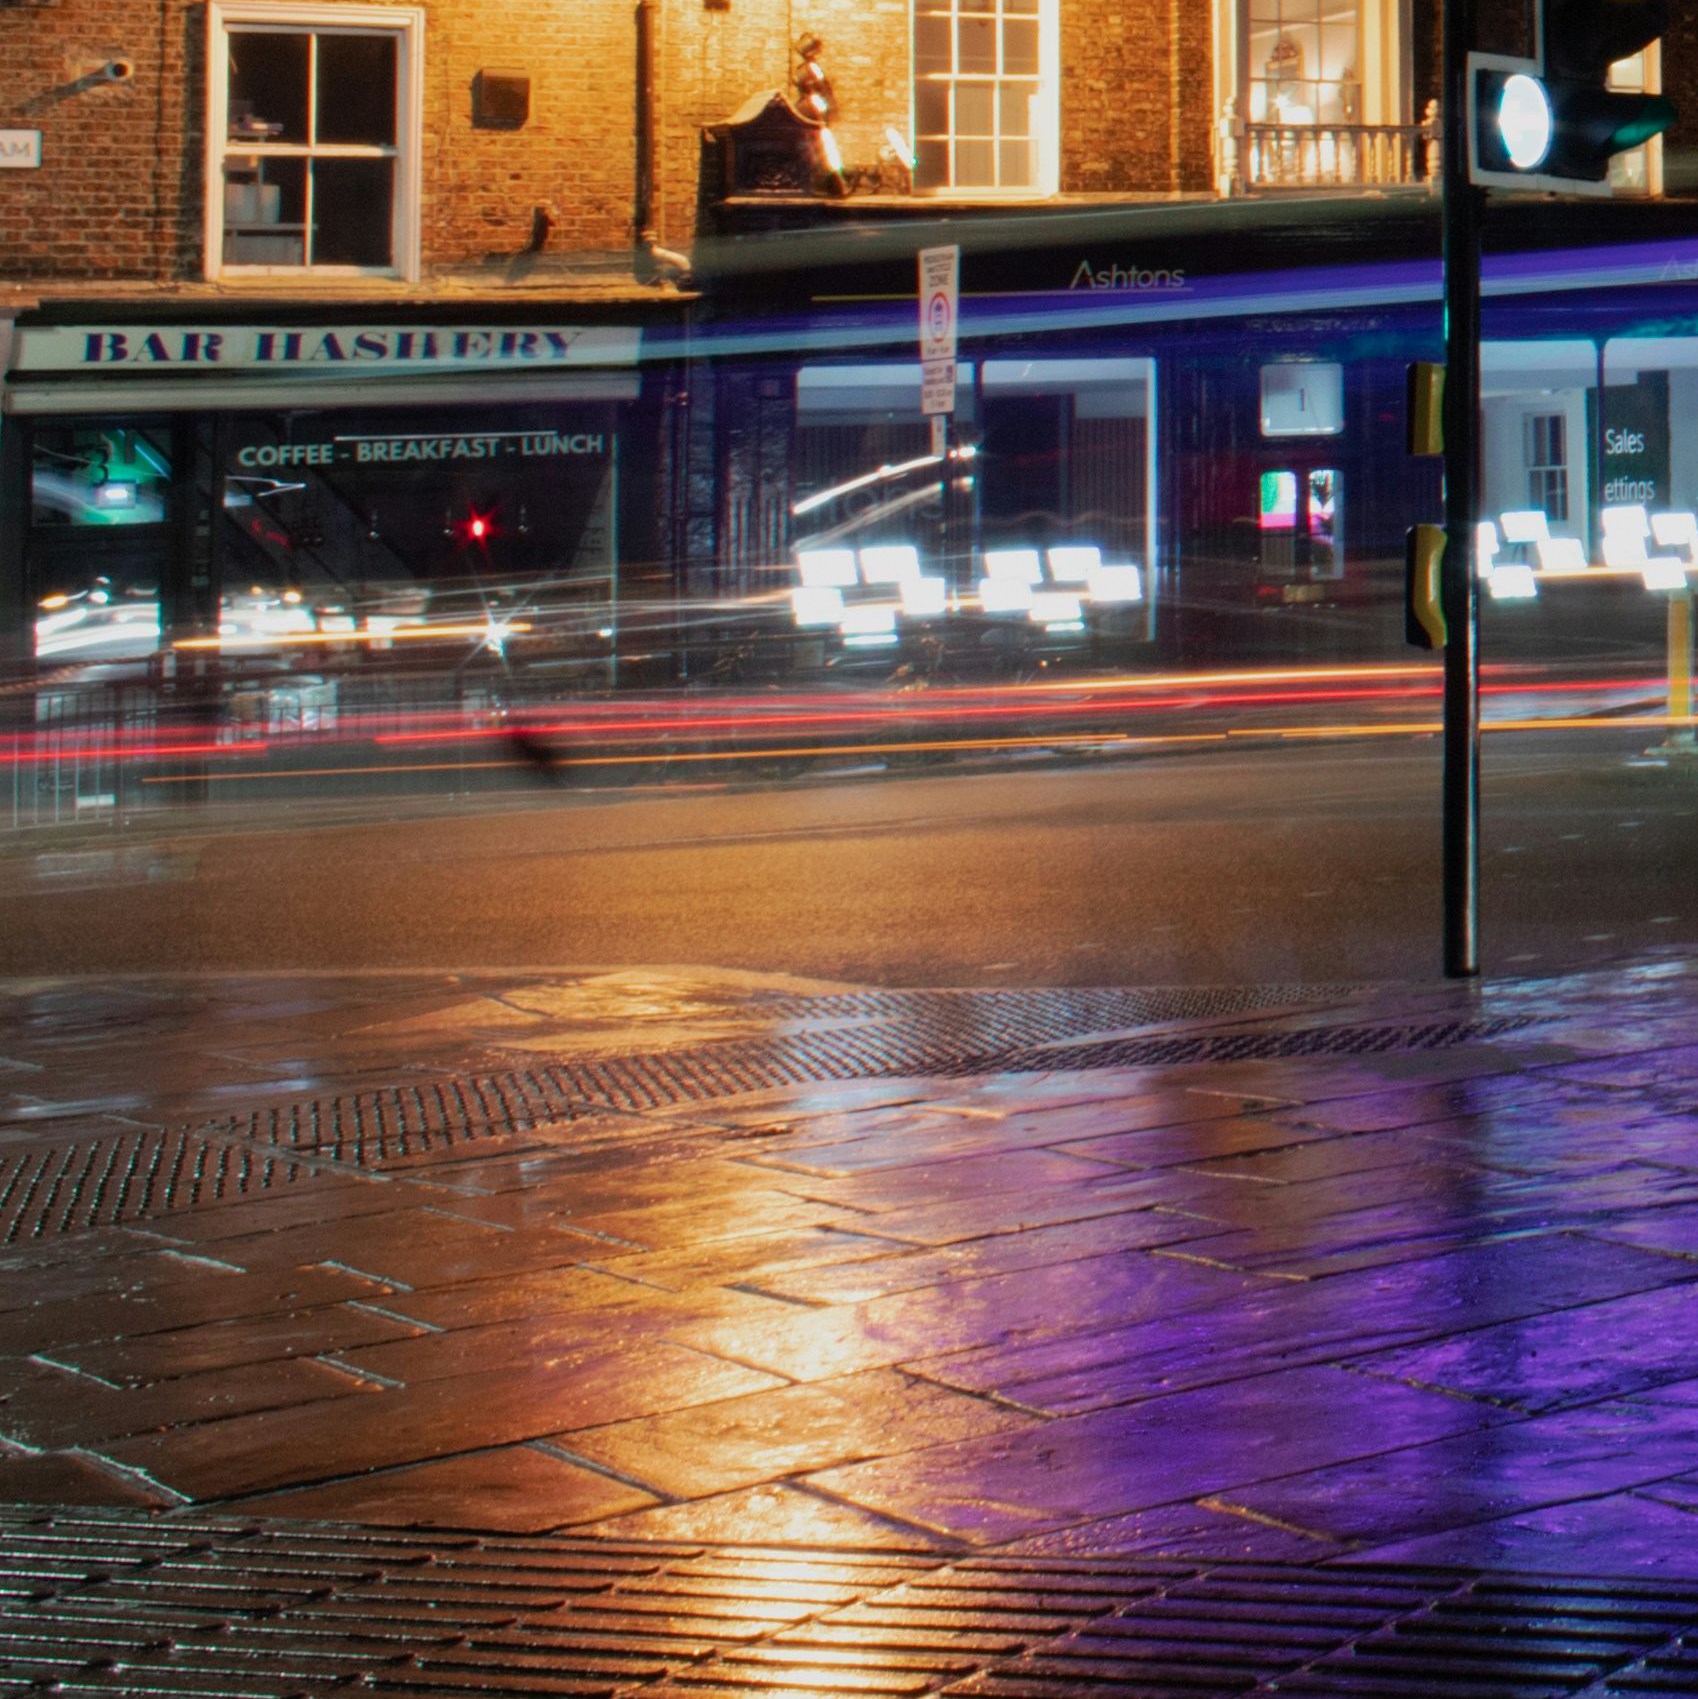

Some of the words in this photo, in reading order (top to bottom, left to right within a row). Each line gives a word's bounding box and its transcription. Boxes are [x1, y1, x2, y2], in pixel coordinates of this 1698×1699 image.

[1069, 259, 1186, 289] Ashtons
[83, 332, 224, 362] BAR
[254, 331, 586, 361] HASHERY
[237, 443, 333, 467] COFFEE
[356, 437, 499, 463] BREAKFAST
[521, 433, 604, 456] LUNCH
[1604, 428, 1645, 454] Sales
